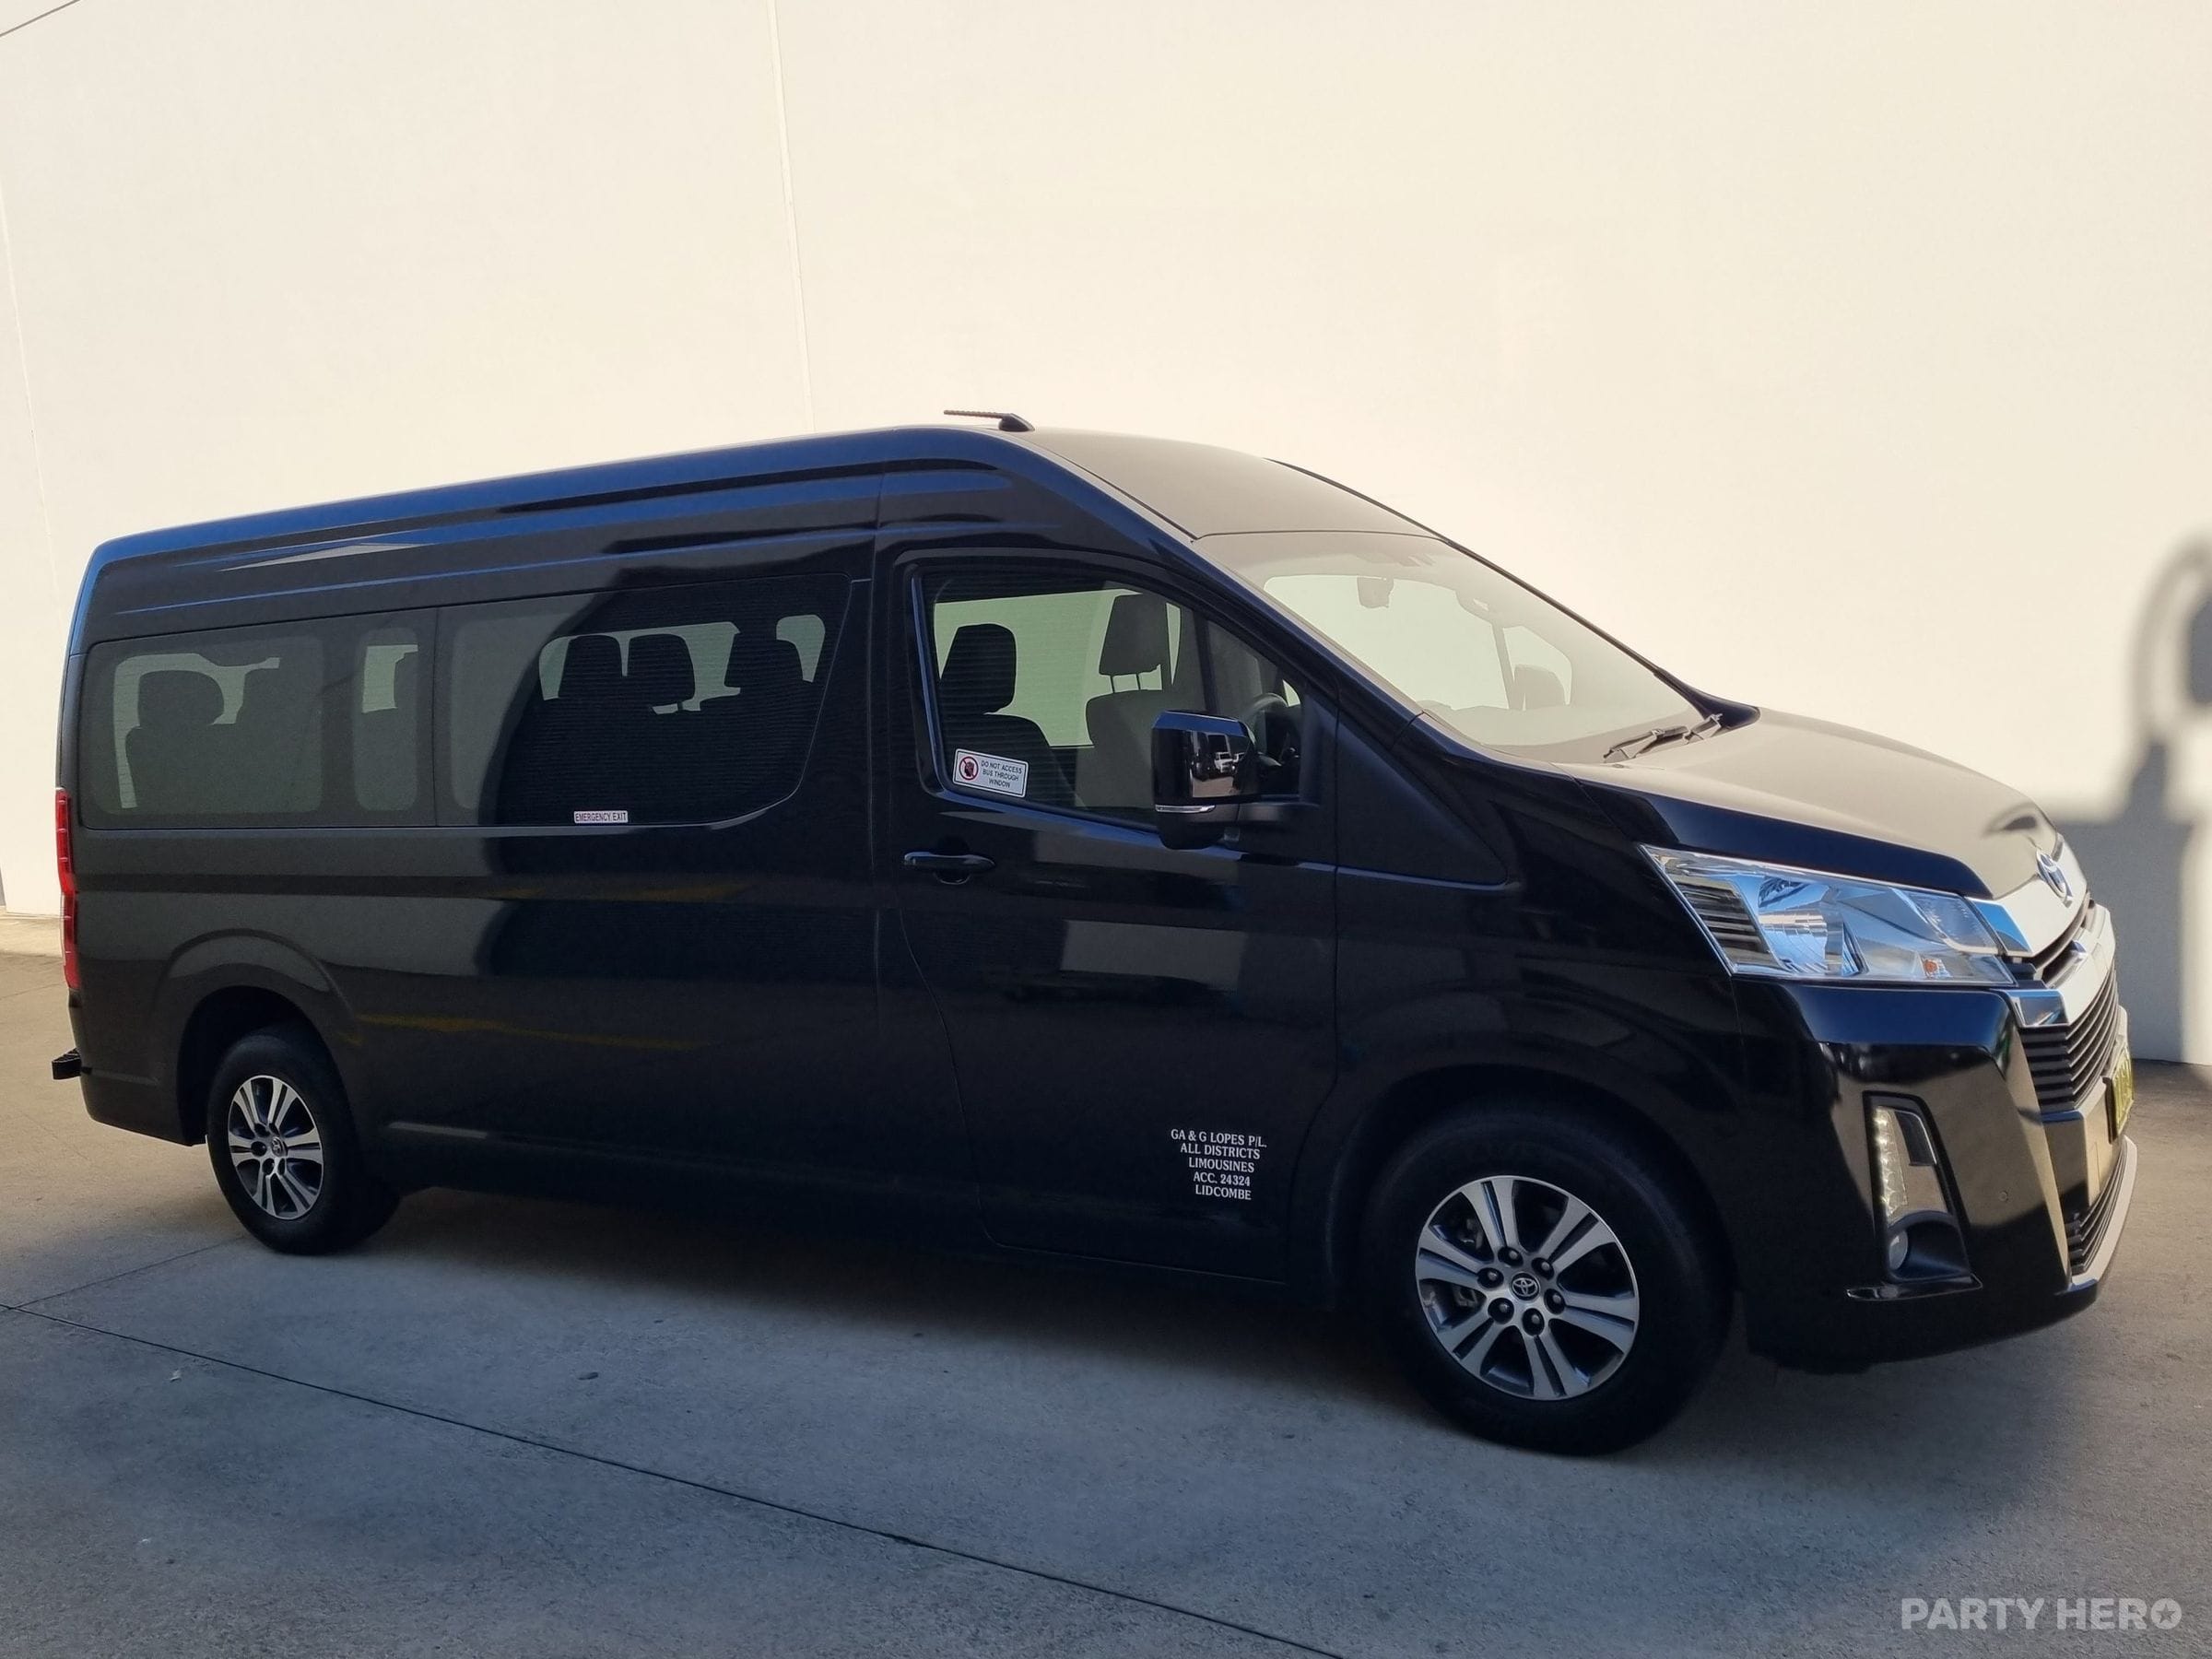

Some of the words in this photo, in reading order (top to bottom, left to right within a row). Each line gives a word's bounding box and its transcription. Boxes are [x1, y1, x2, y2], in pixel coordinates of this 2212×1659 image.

[994, 771, 1018, 781] THROUGH
[1002, 764, 1022, 774] ACCESS
[988, 778, 1010, 788] WINDOW
[575, 812, 610, 821] EMERGENCY
[612, 812, 627, 821] EXIT
[1171, 1128, 1186, 1140] GA
[1188, 1130, 1196, 1142] &
[1198, 1131, 1207, 1142] G
[1210, 1132, 1245, 1146] LOPES
[1180, 1142, 1201, 1155] ALL
[1204, 1144, 1261, 1159] DISTRICTS
[1188, 1157, 1254, 1173] LIMOUSINES
[1193, 1171, 1218, 1183] ACC.
[1220, 1173, 1251, 1186] 24324
[1195, 1184, 1252, 1200] LIDCOMBE
